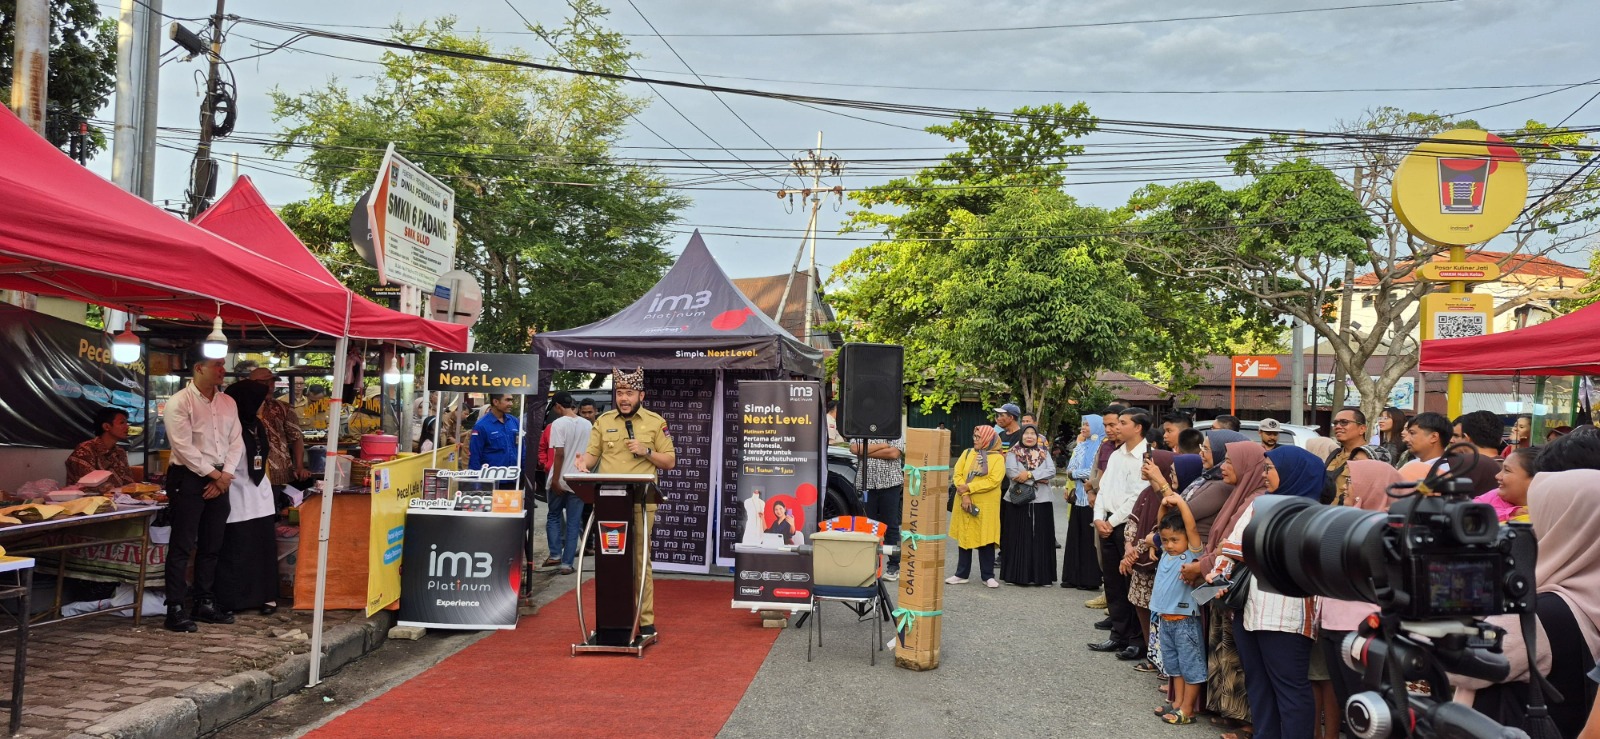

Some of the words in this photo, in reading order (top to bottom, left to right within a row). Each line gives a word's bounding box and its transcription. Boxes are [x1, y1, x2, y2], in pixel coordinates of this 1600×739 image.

[388, 192, 411, 223] SMKN
[412, 205, 417, 226] 6
[418, 208, 447, 240] PADANG
[404, 226, 415, 239] SMK
[648, 290, 712, 313] im3
[546, 349, 564, 358] im3
[566, 348, 616, 358] Platinum
[676, 350, 707, 359] Simple.
[707, 349, 729, 357] Next
[731, 348, 758, 357] Level.
[440, 360, 492, 374] Simple.
[439, 373, 478, 386] Next
[482, 374, 531, 387] Level.
[790, 384, 813, 397] im3
[744, 404, 784, 414] Simple.
[743, 414, 773, 424] Next
[776, 414, 812, 425] Level.
[480, 464, 519, 478] im3
[411, 499, 439, 508] Simpel
[428, 544, 493, 578] im3
[428, 579, 491, 591] Platinum
[436, 599, 480, 607] Experience
